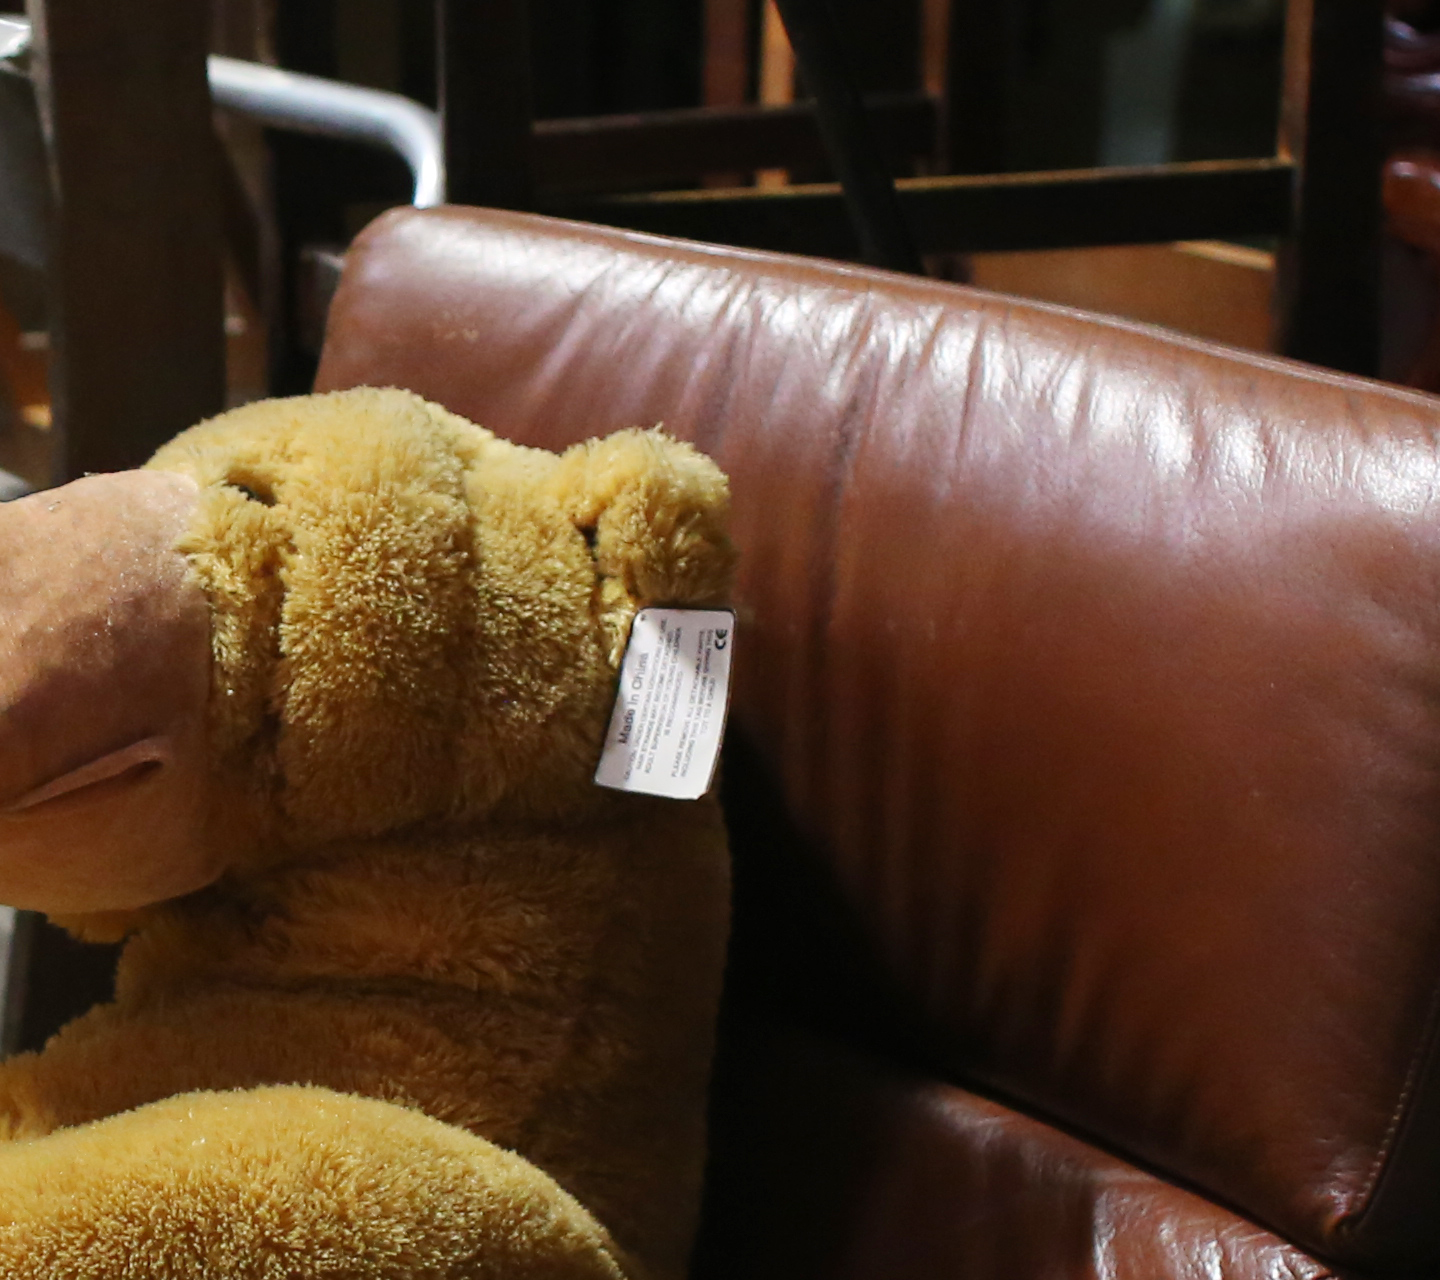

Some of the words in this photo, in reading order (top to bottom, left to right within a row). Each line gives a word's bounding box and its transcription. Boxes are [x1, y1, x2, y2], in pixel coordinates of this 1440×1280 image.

[631, 651, 648, 691] China
[627, 692, 638, 706] In
[618, 707, 635, 744] Made
